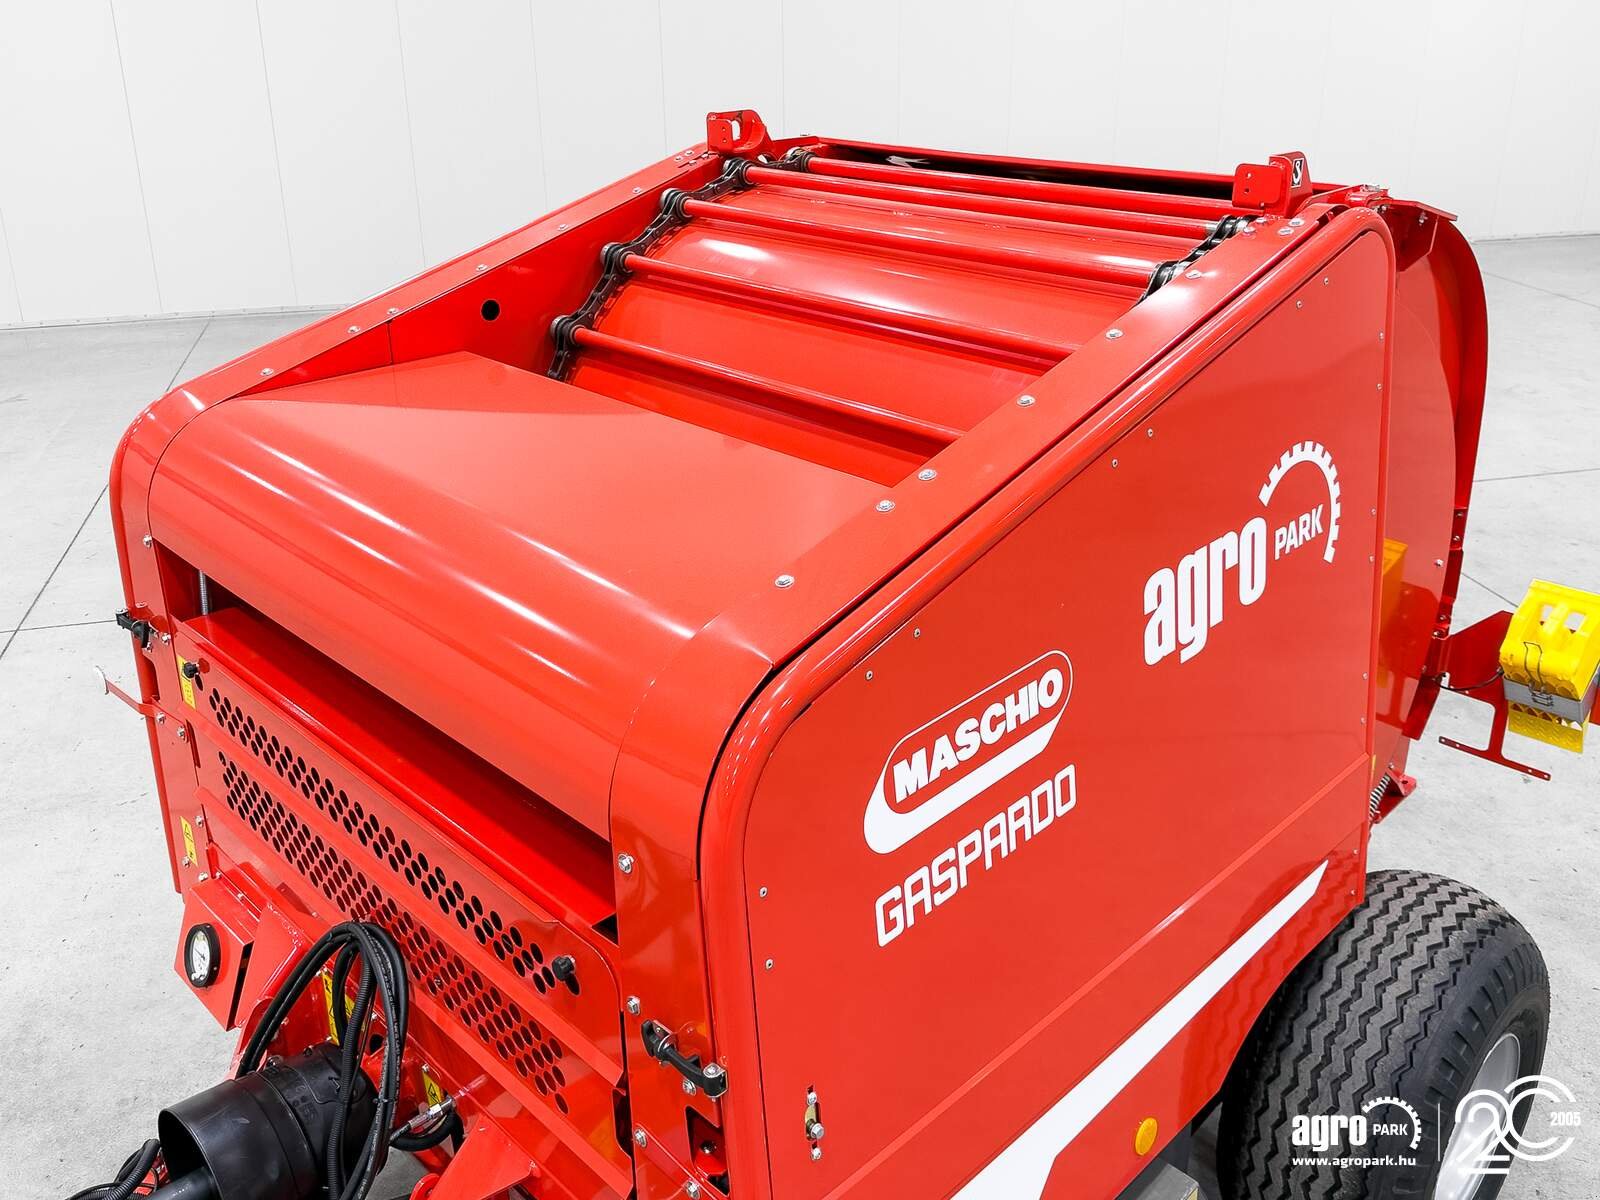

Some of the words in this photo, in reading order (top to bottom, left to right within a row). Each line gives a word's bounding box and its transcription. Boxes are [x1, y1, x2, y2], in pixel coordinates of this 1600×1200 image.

[1144, 516, 1267, 666] agro
[1274, 504, 1324, 561] PARK
[892, 668, 1063, 803] MASCHIO
[875, 763, 1077, 947] GASPARDO
